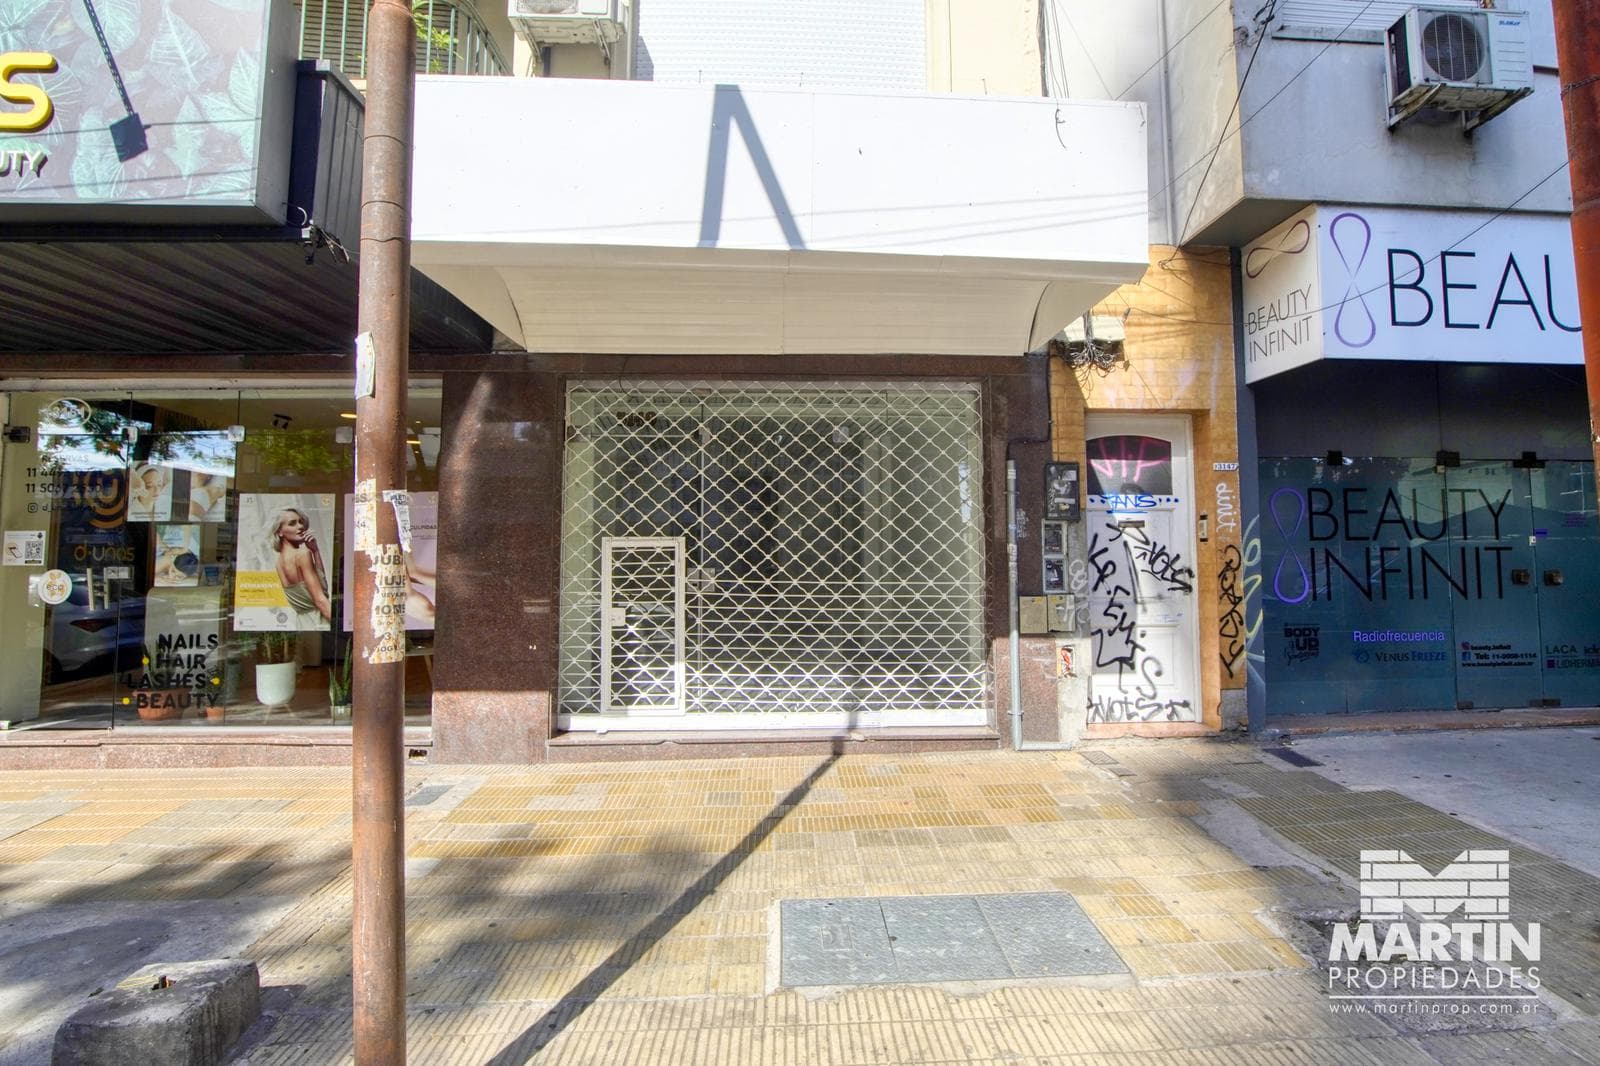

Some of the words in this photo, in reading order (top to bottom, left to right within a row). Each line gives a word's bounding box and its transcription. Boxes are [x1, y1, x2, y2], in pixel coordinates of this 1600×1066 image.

[1247, 284, 1311, 335] BEAUTY
[1249, 315, 1312, 363] INFINIT
[1307, 487, 1512, 541] BEAUTY
[1310, 547, 1512, 600] INFINIT
[1284, 627, 1320, 637] BODY
[1353, 630, 1445, 642] Radiofrecuencia
[158, 633, 219, 649] NAILS
[1375, 651, 1409, 662] VENUS
[1545, 644, 1577, 655] LACA
[155, 653, 206, 669] HAIR
[127, 673, 206, 689] LASHES
[136, 693, 219, 709] BEAUTY
